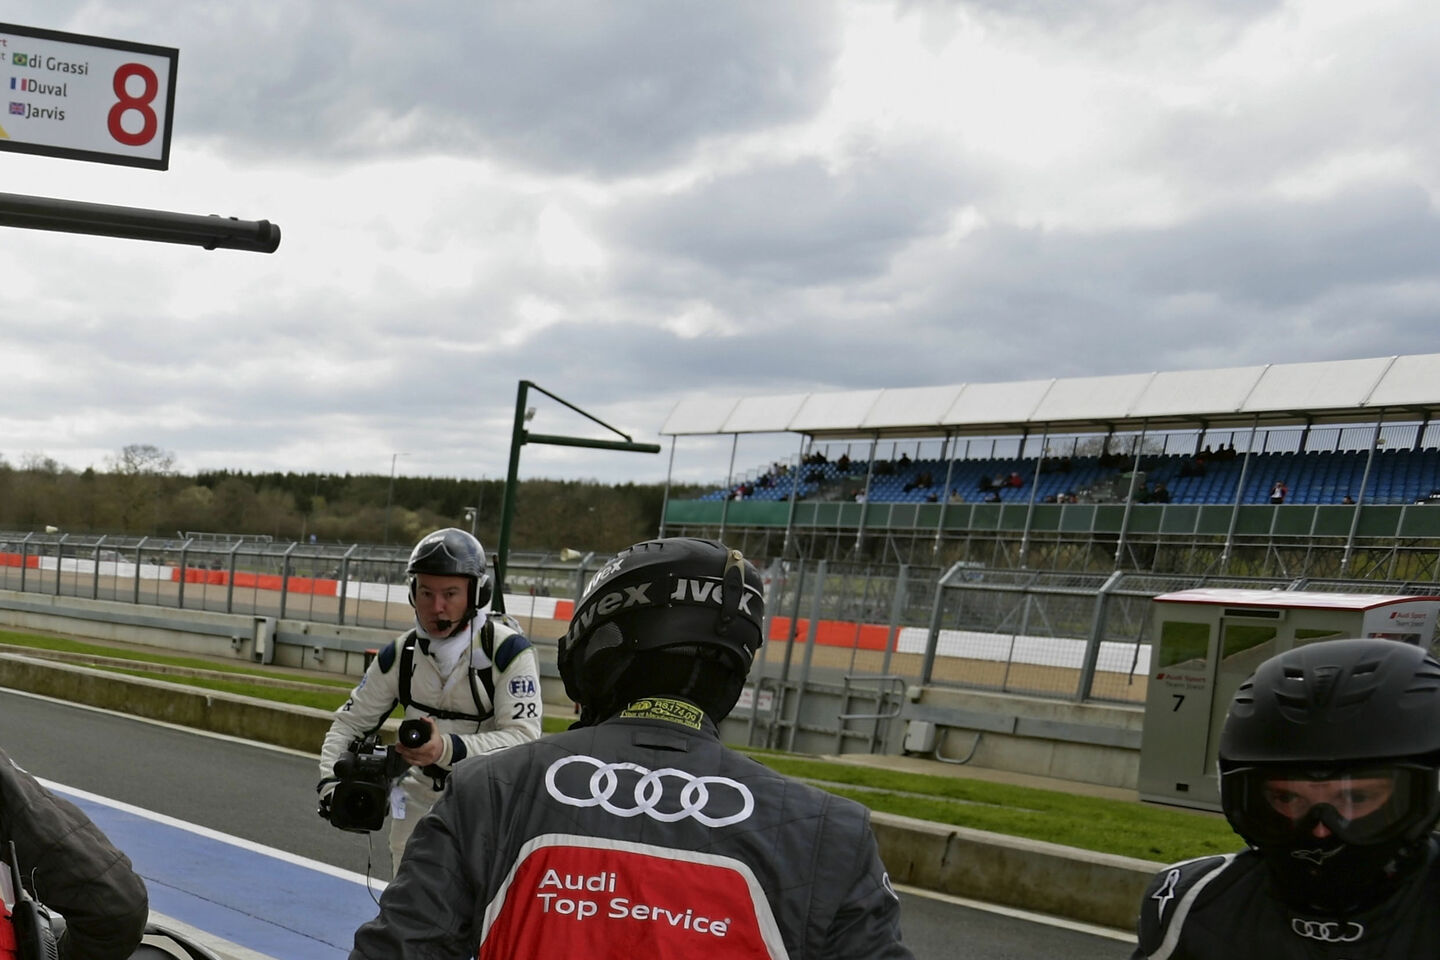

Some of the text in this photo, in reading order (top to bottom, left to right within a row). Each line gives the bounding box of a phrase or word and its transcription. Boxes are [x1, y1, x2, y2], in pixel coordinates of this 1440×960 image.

[28, 54, 89, 76] di Grassi
[27, 79, 68, 98] Duval
[25, 102, 66, 122] Jarvis
[107, 62, 159, 147] 8
[583, 558, 624, 598] uvex
[566, 582, 652, 650] uvex
[511, 680, 537, 697] FIA
[512, 701, 539, 720] 28
[1172, 694, 1186, 712] 7
[538, 868, 617, 893] Audi
[536, 892, 729, 938] Top Service
